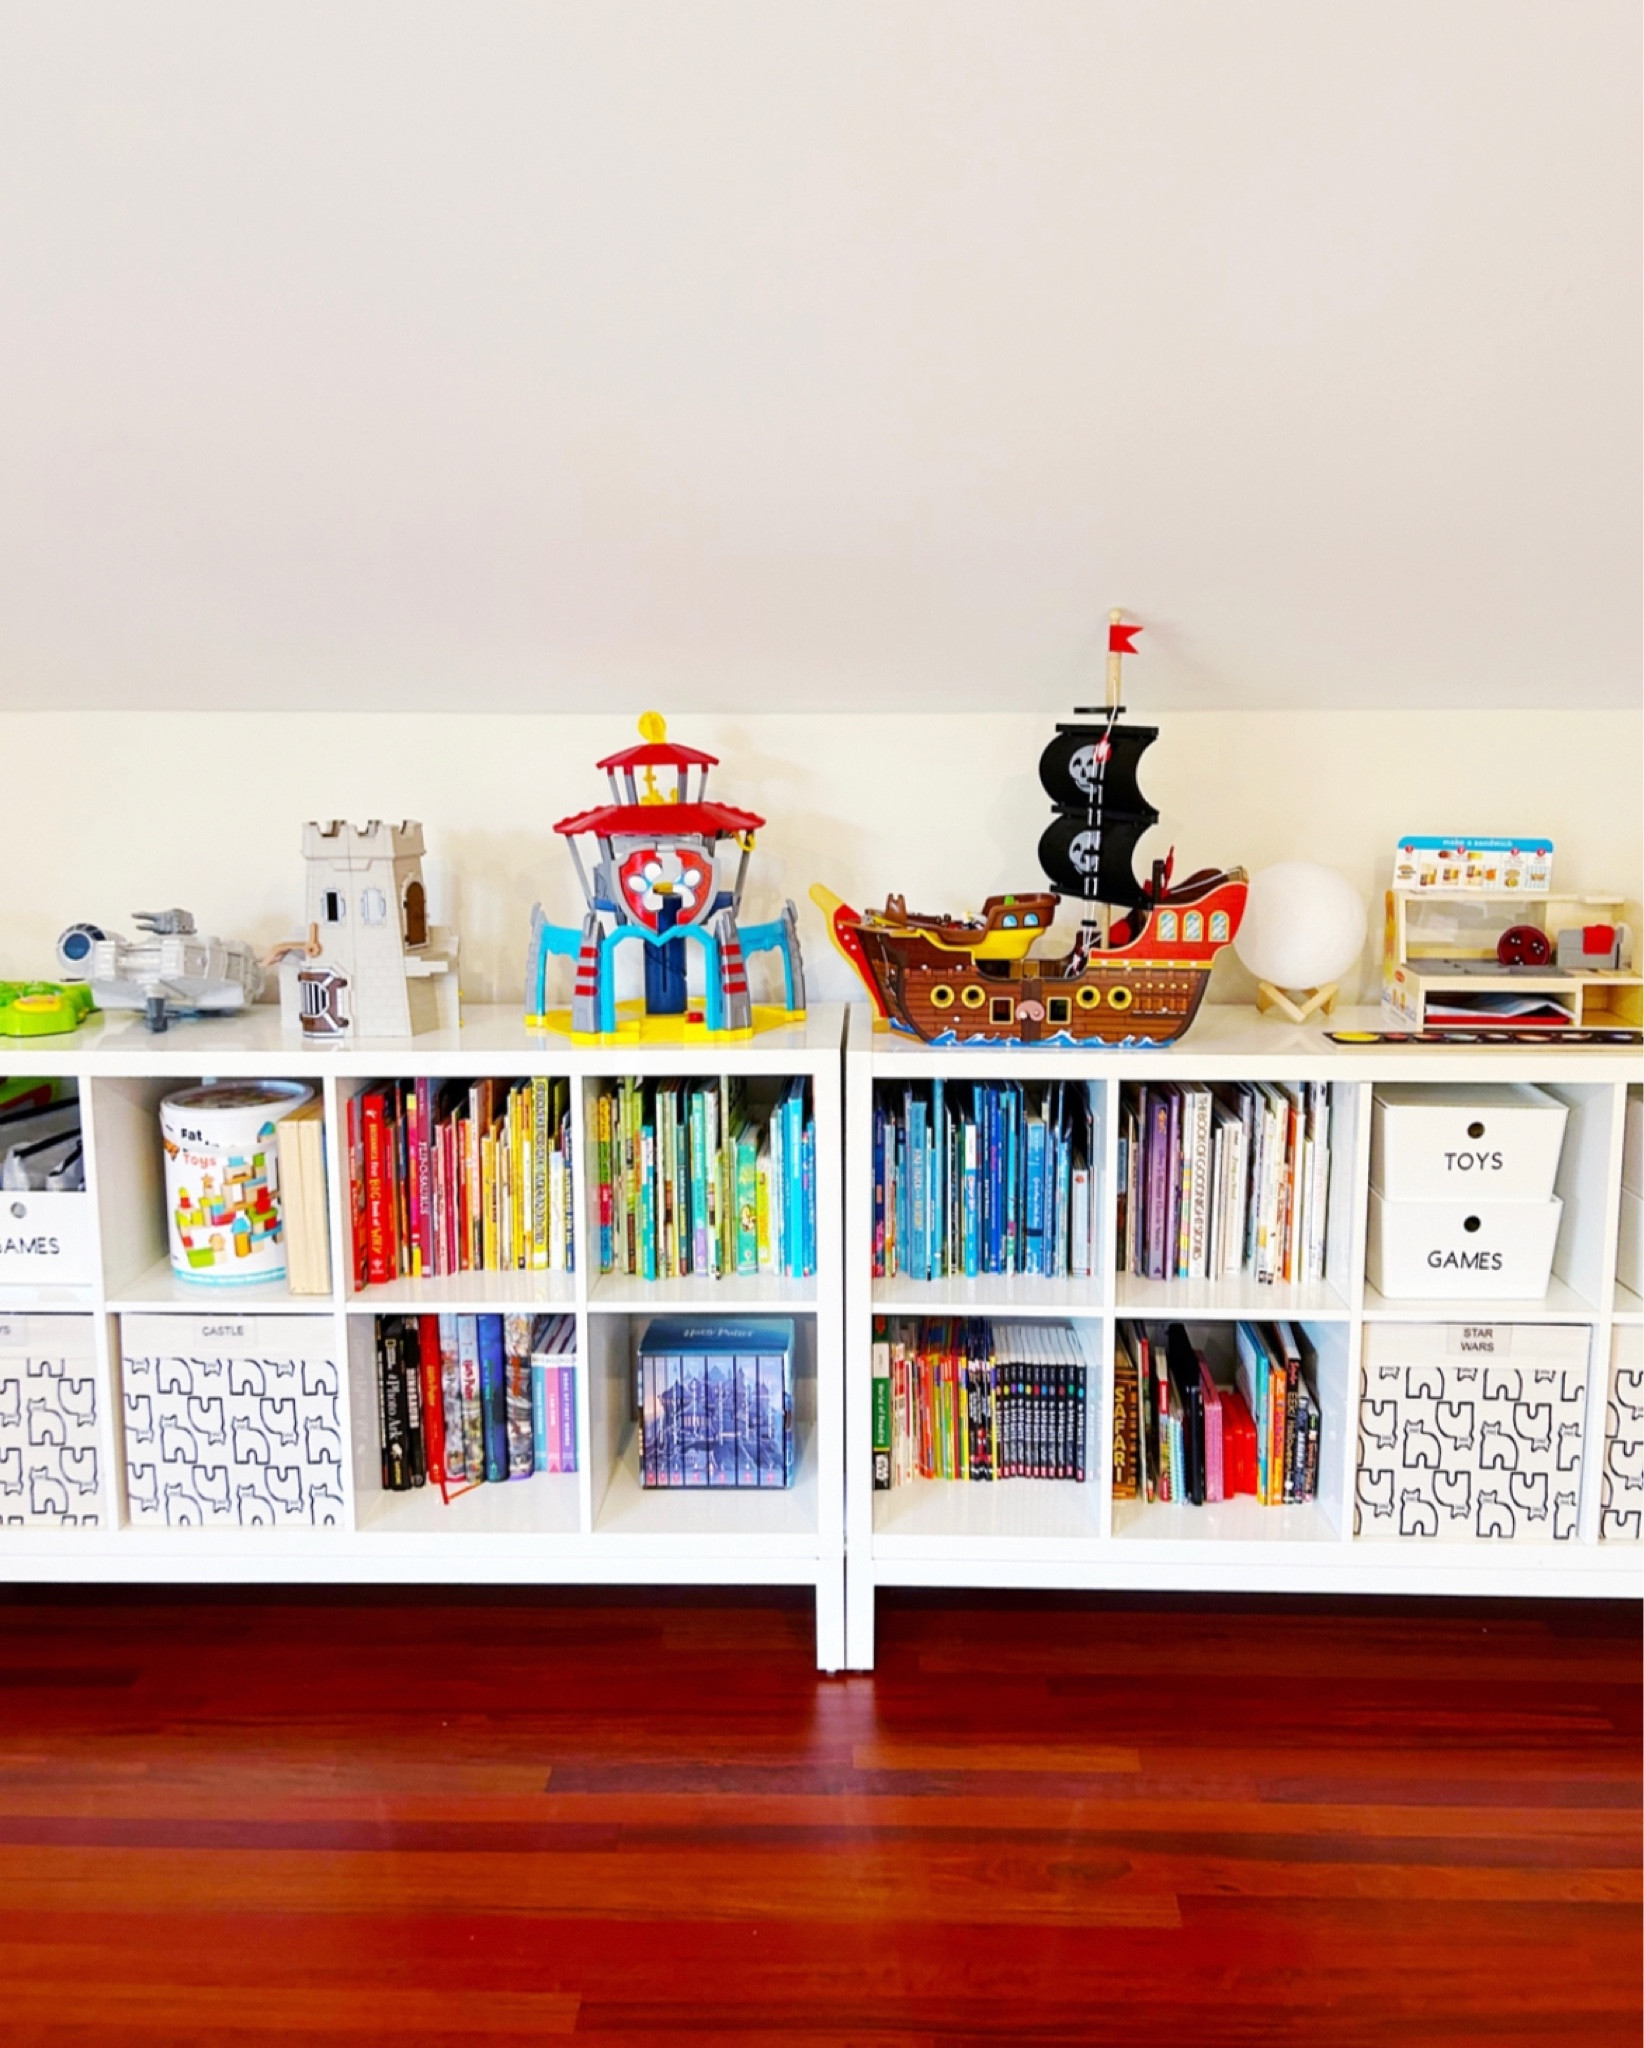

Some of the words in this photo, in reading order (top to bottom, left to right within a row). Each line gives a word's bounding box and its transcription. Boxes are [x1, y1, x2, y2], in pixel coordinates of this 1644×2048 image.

[181, 1128, 202, 1141] Fat
[183, 1154, 216, 1168] Toys
[1445, 1152, 1503, 1171] TOYS
[1427, 1250, 1502, 1271] GAMES
[202, 1326, 244, 1337] CASTLE
[1463, 1328, 1493, 1338] STAR
[1461, 1342, 1494, 1352] WARS
[387, 1381, 401, 1416] Photo
[388, 1417, 402, 1440] Ark
[1113, 1386, 1126, 1482] SAFARI
